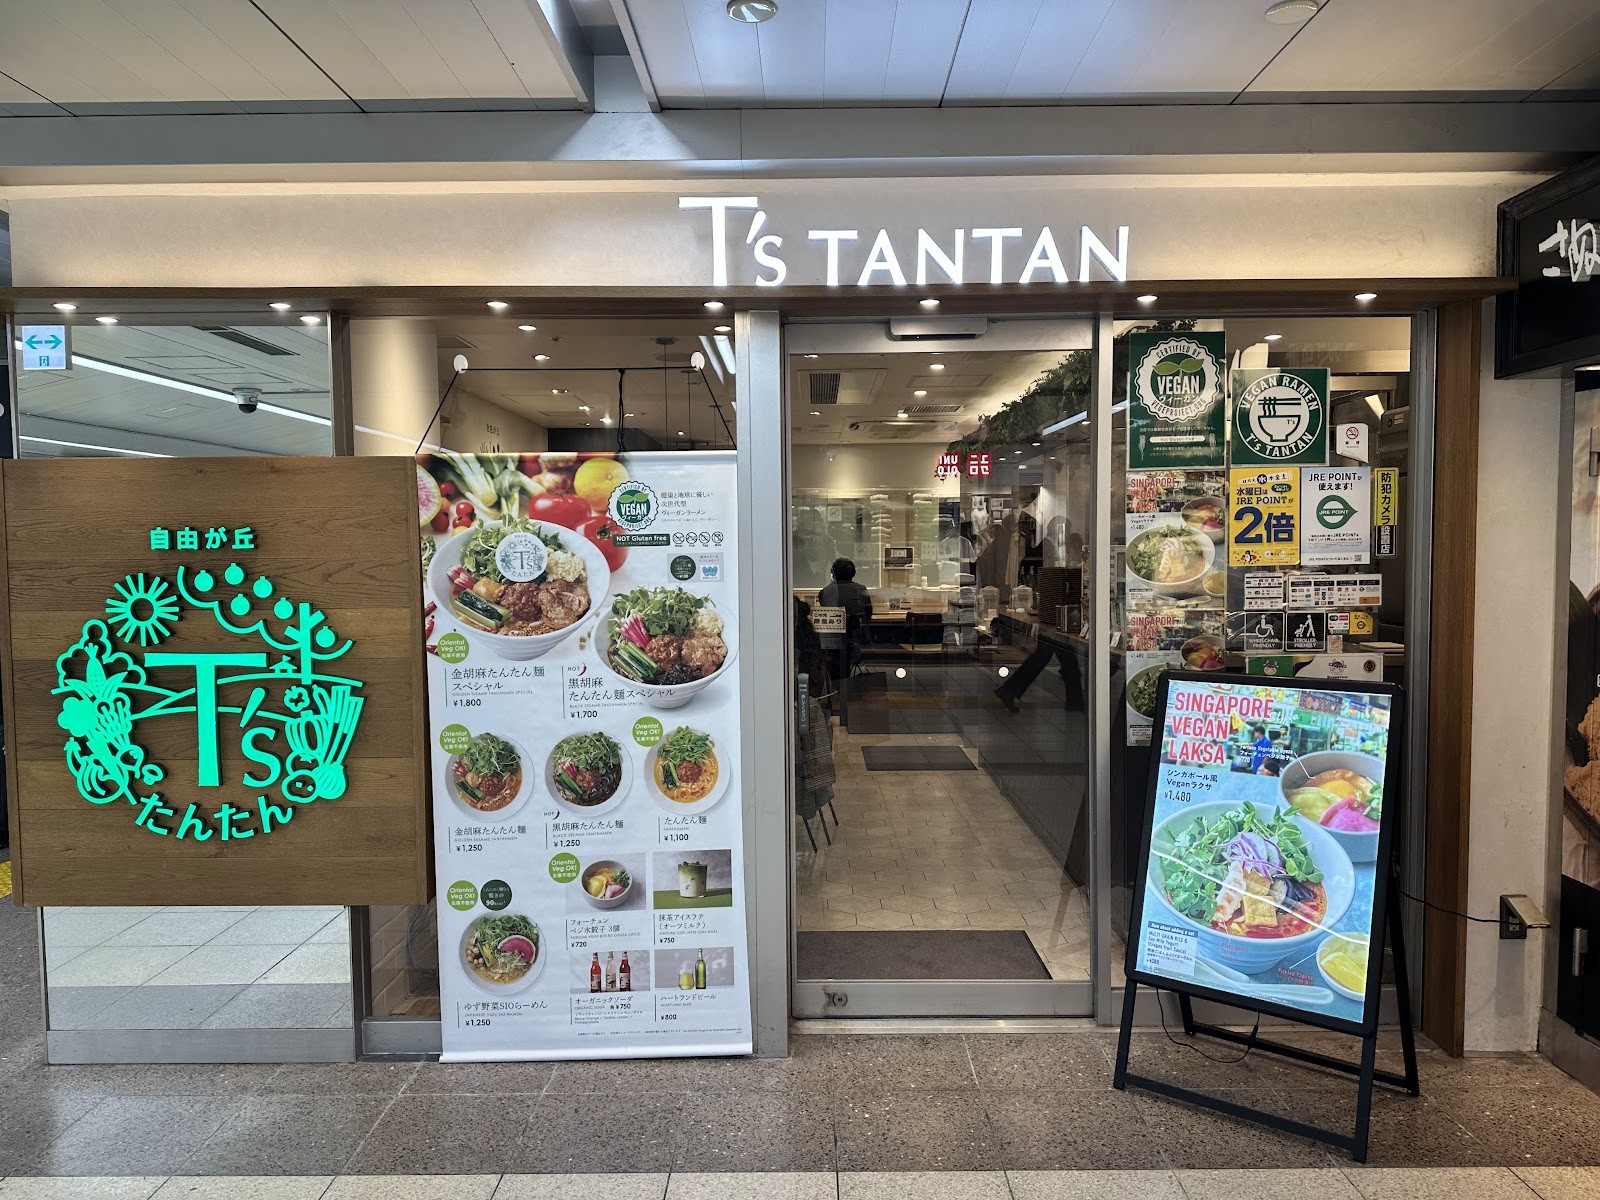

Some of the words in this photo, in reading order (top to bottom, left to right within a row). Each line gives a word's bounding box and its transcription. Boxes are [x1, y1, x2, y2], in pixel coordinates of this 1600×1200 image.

[678, 196, 787, 287] T's
[808, 225, 1129, 286] TANTAN
[1155, 344, 1191, 359] CERTIFIED
[1191, 347, 1202, 358] BY
[1157, 375, 1200, 395] VEGAN
[1240, 376, 1277, 409] VEGAN
[1281, 376, 1319, 411] RAMEN
[1151, 397, 1207, 417] VEGEPROJECT.ORG
[1245, 432, 1262, 451] T's
[1265, 432, 1314, 457] TANTAN
[1130, 477, 1177, 489] SINGAPORE
[1308, 472, 1326, 482] JRE
[1130, 489, 1158, 500] VEGAN
[1236, 487, 1268, 496] 水曜日は
[1236, 497, 1253, 505] JRE
[620, 503, 647, 516] VEGAN
[1234, 506, 1295, 544] 2倍
[149, 526, 258, 550] 自由が丘
[1130, 616, 1177, 627] SINGAPORE
[1130, 628, 1158, 638] VEGAN
[451, 666, 545, 680] 金胡麻たんたん麺
[452, 682, 504, 692] スペシャル
[568, 677, 604, 689] 黒胡麻
[569, 689, 676, 702] たんたん麺スペシャル
[453, 699, 482, 708] ¥1,800
[1174, 691, 1275, 719] SINGAPORE
[570, 711, 598, 719] ¥1,700
[1268, 710, 1299, 724] Style
[1171, 715, 1230, 740] VEGAN
[1167, 739, 1225, 765] LAKSA
[1167, 769, 1218, 783] シンガポール風
[1166, 778, 1213, 790] Veganラクサ
[1164, 790, 1191, 802] ¥1,480
[134, 791, 297, 842] たんたん
[664, 816, 708, 825] たんたん麺
[454, 825, 527, 837] 金胡麻たんたん麺
[552, 820, 624, 832] 黒胡麻たんたん麺
[553, 840, 581, 848] ¥1,250
[663, 834, 689, 842] ¥1,100
[455, 844, 482, 852] ¥1,250
[570, 917, 609, 926] フォーチュン
[658, 913, 705, 922] 抹茶アイスラテ
[608, 924, 620, 932] 3個
[574, 996, 634, 1005] オーガニックソーダ
[660, 994, 716, 1002] ハートランドビール
[464, 1000, 548, 1011] ゆず野菜SIOらーめん
[465, 1019, 491, 1027] ¥1,250
